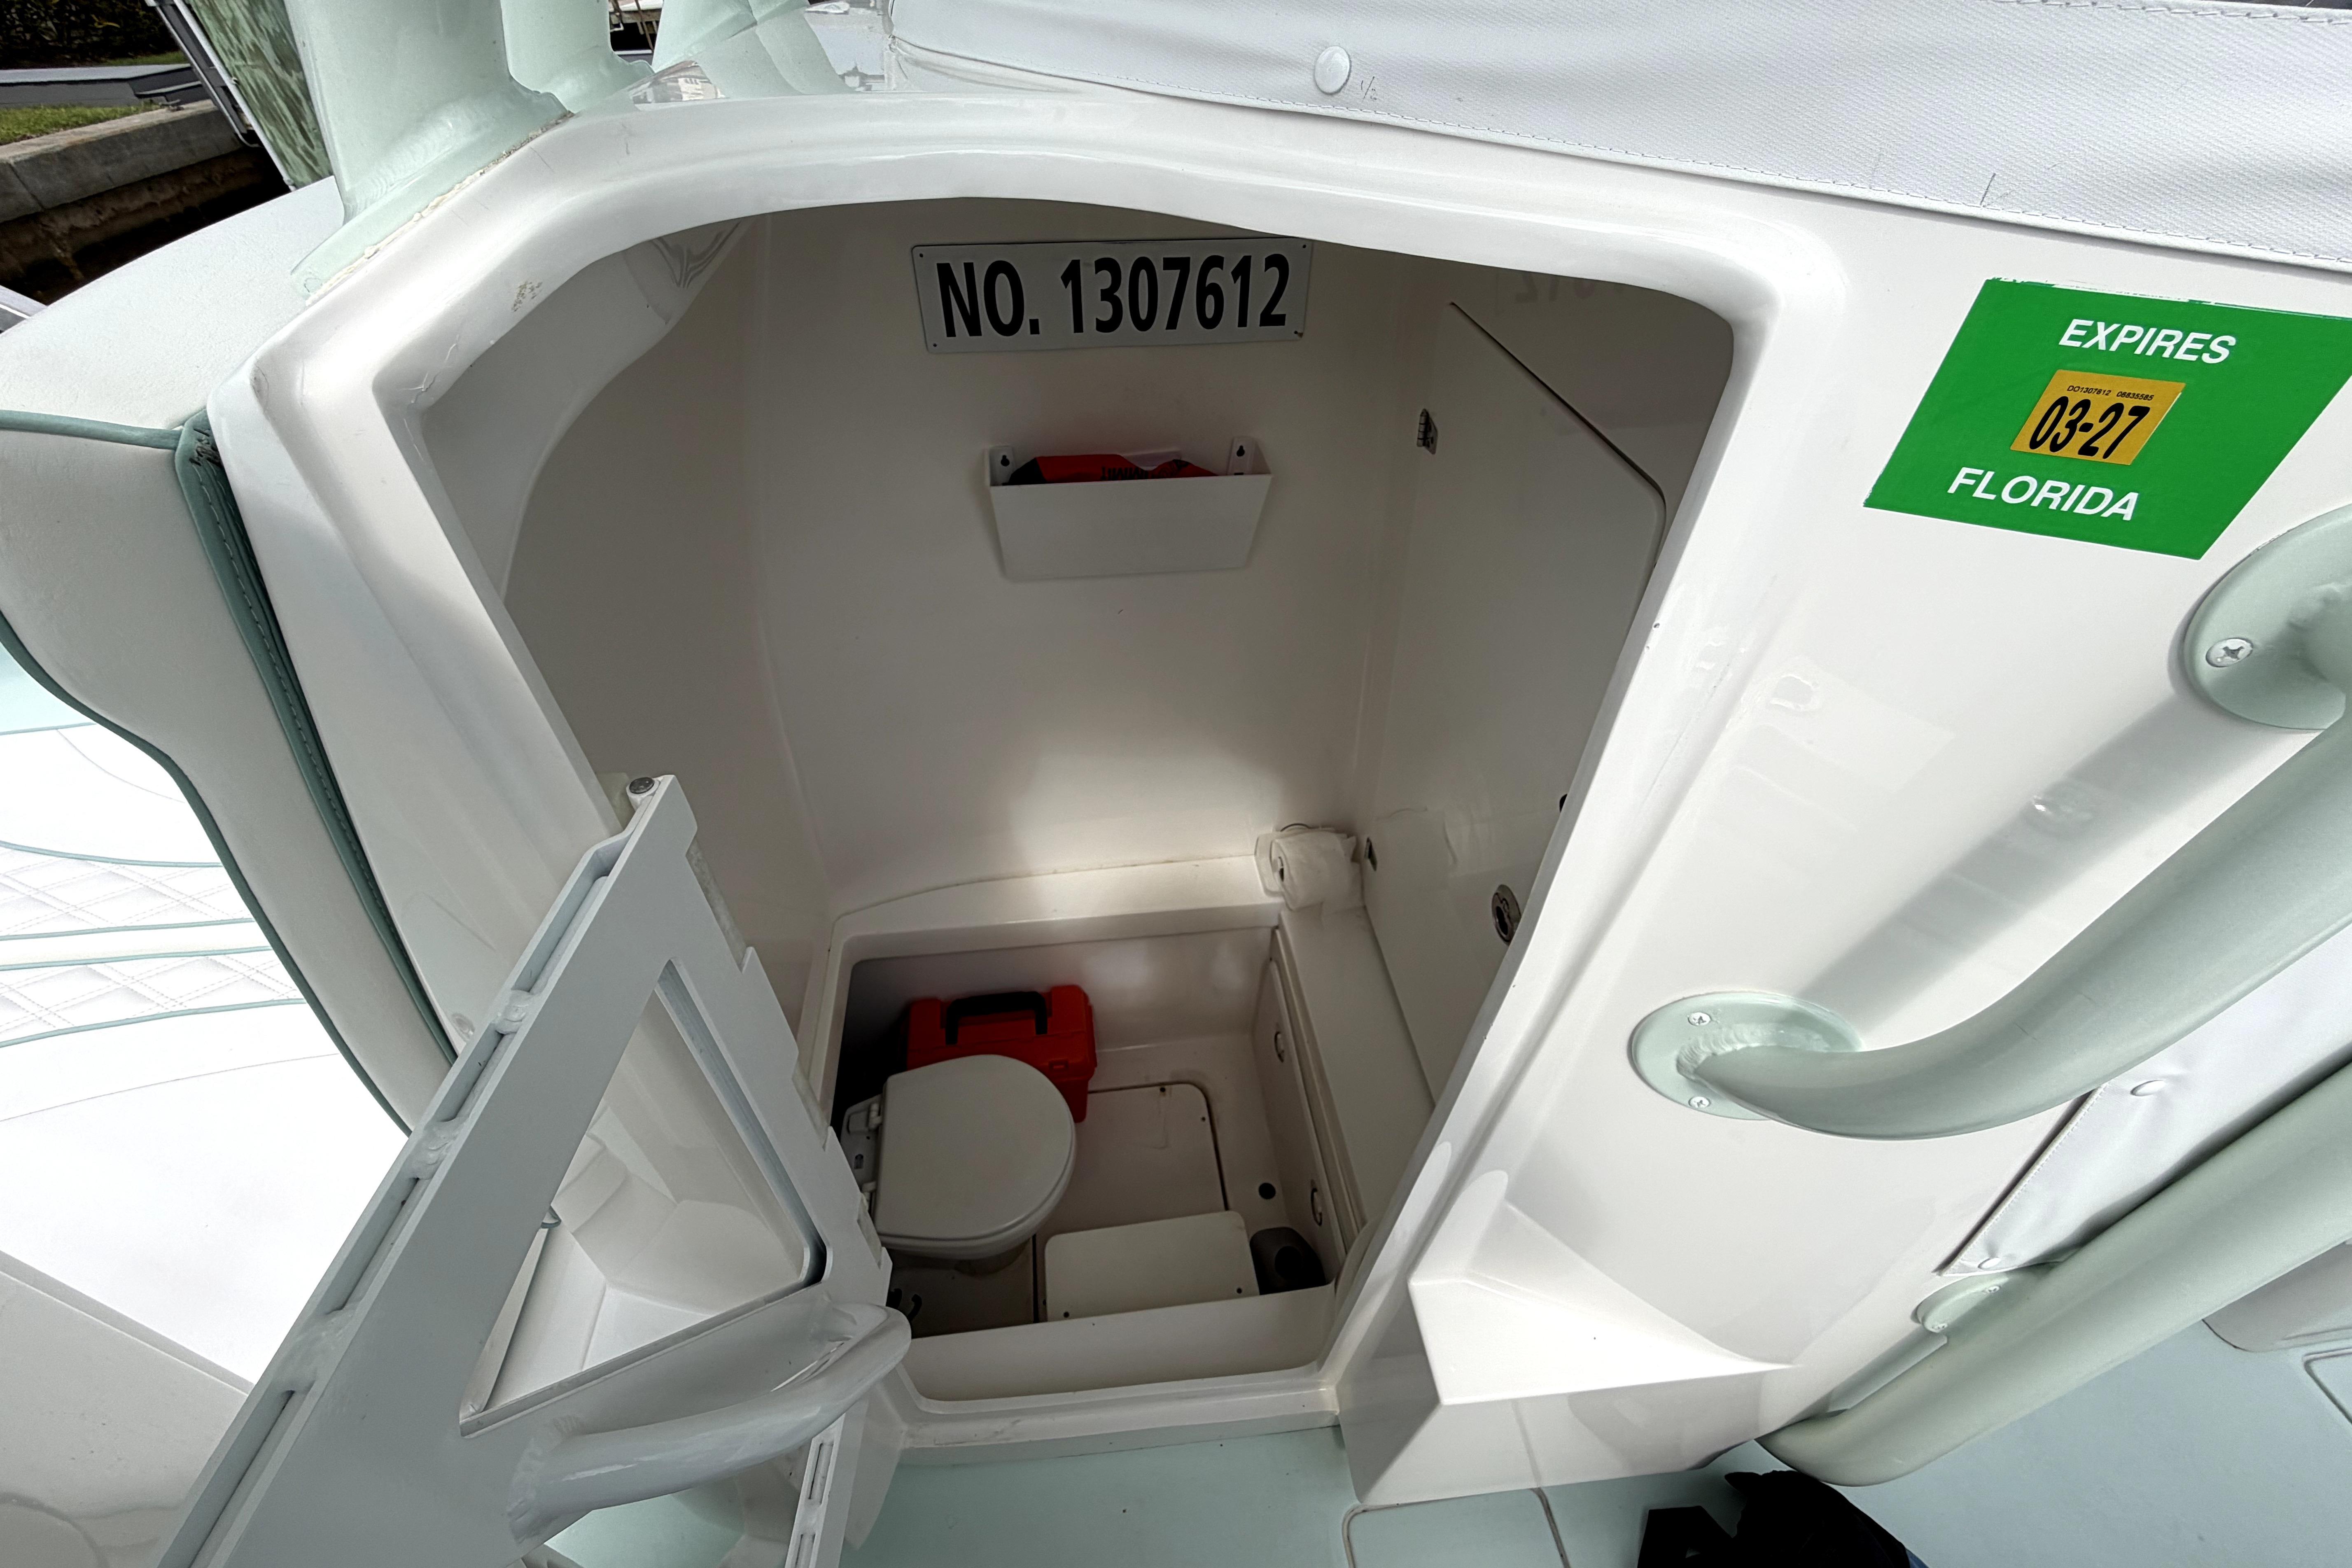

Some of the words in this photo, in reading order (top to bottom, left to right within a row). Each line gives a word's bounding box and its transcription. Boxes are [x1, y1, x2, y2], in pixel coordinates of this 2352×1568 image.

[936, 260, 1040, 338] NO.
[1060, 253, 1290, 334] 1307612
[2059, 318, 2236, 364] EXPIRES
[2029, 396, 2150, 459] 03-27
[1947, 467, 2140, 521] FLORIDA
